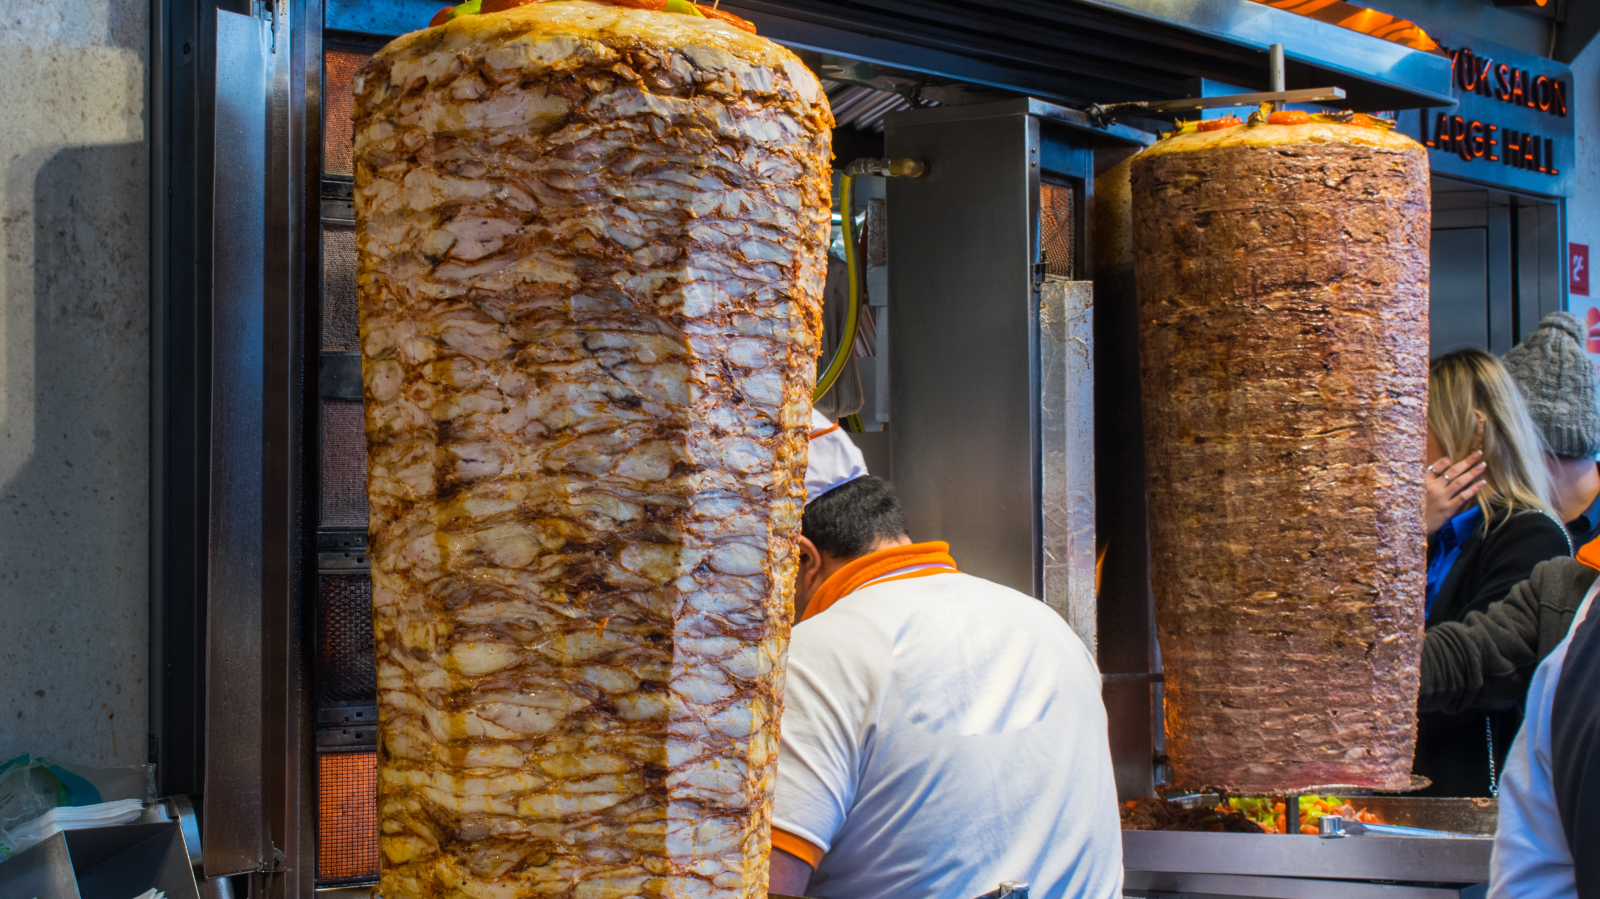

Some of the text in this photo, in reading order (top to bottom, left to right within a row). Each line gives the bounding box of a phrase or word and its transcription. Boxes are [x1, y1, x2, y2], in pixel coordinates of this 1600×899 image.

[1439, 46, 1567, 117] YÜK SALON
[1420, 108, 1559, 175] LARGE HALL
